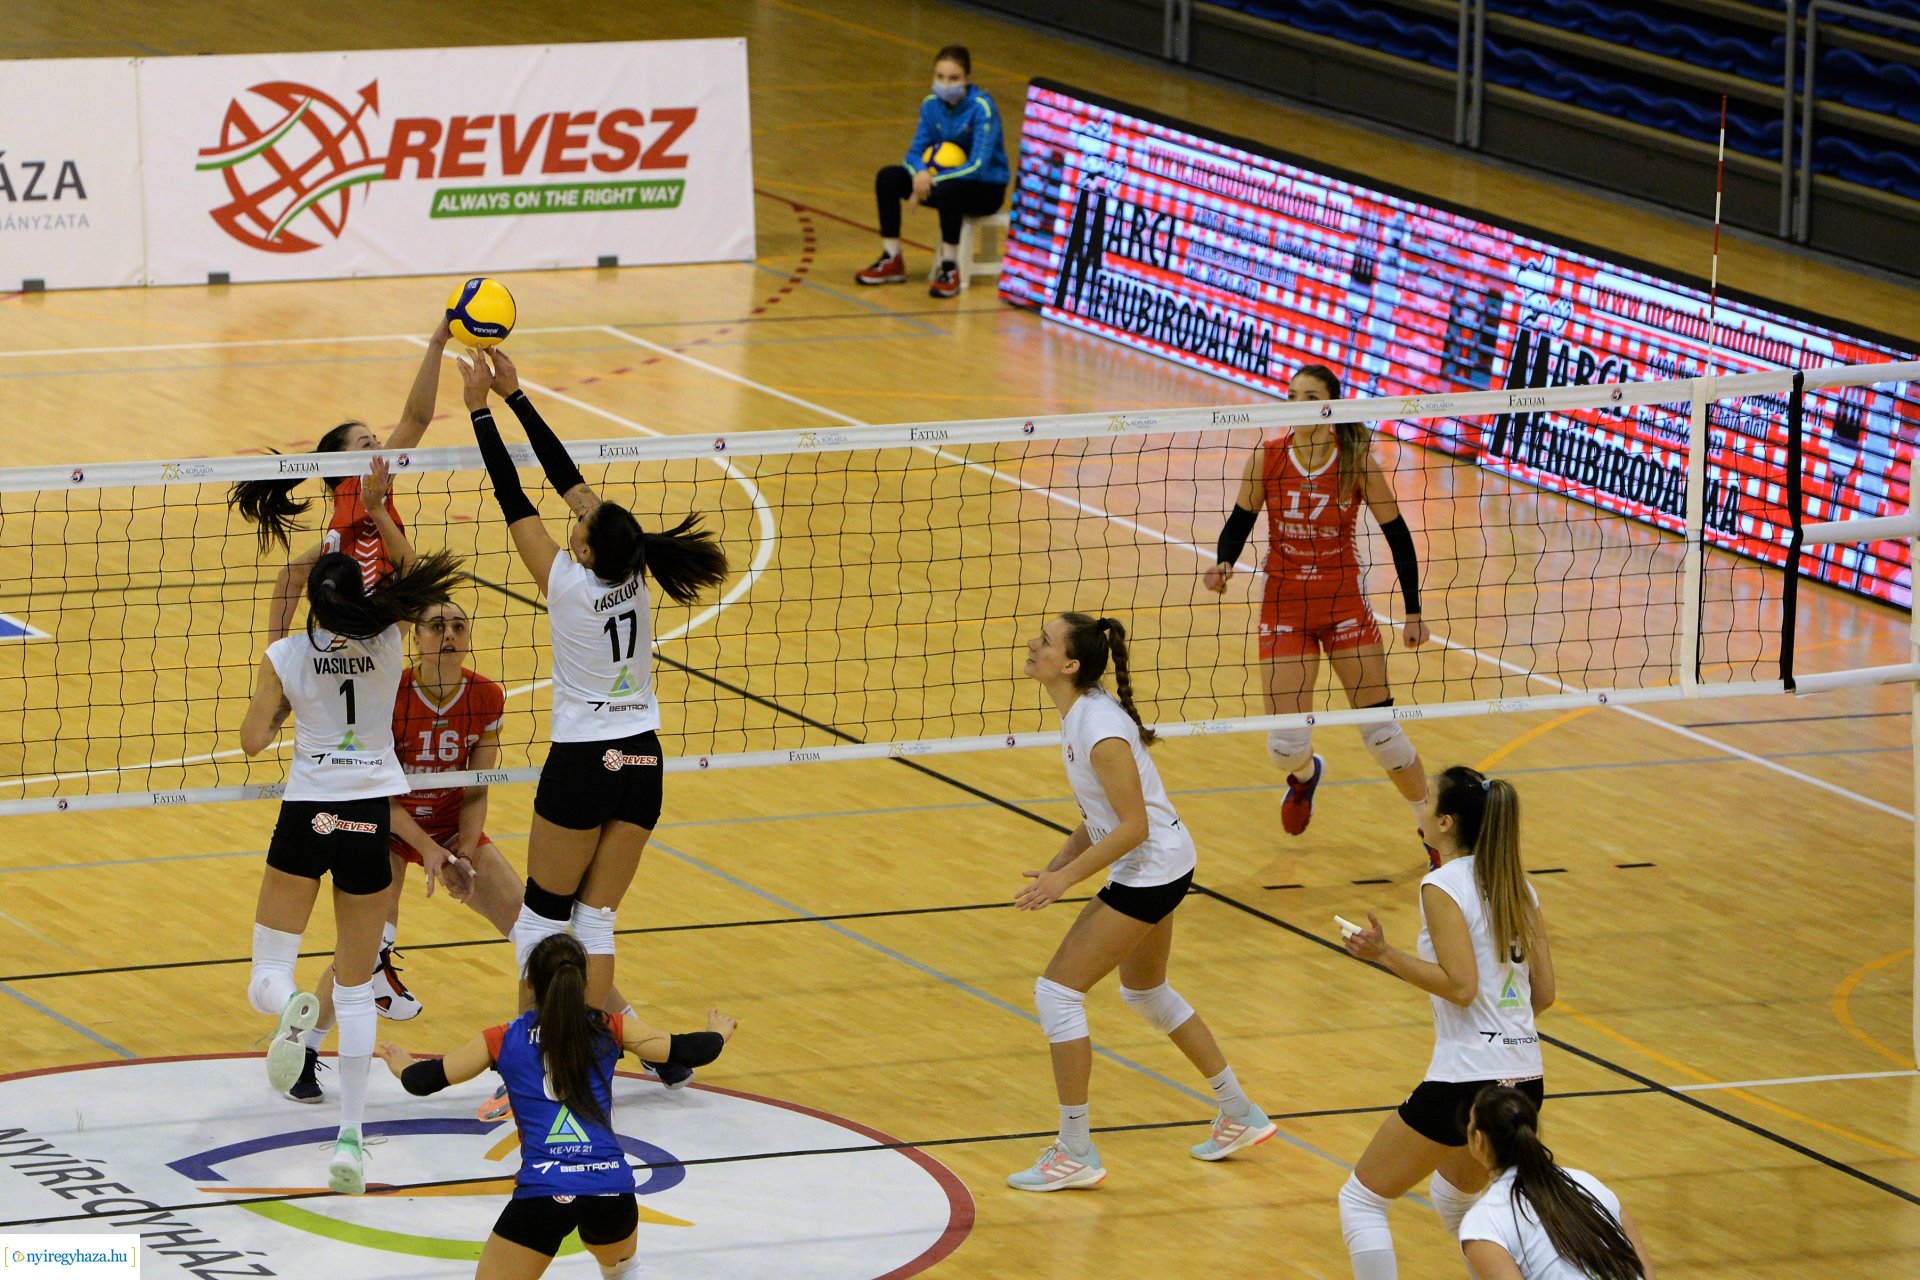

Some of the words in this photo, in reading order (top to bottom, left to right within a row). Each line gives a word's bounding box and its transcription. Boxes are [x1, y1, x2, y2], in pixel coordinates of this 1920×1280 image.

[436, 191, 511, 212] ALWAYS
[513, 191, 541, 208] ON
[543, 189, 580, 207] THE
[582, 187, 637, 205] RIGHT
[639, 185, 682, 203] WAY
[0, 212, 89, 231] ÁNYZATA
[473, 326, 499, 336] MIKASA
[1283, 490, 1330, 521] 17
[603, 609, 637, 663] 17
[313, 656, 376, 675] VASILEVA
[339, 679, 356, 725] 1
[415, 730, 460, 762] 16
[336, 819, 377, 834] REVESZ
[550, 1145, 581, 1155] KE-VIZ
[582, 1145, 593, 1153] 21
[560, 1161, 620, 1173] BESTRONG
